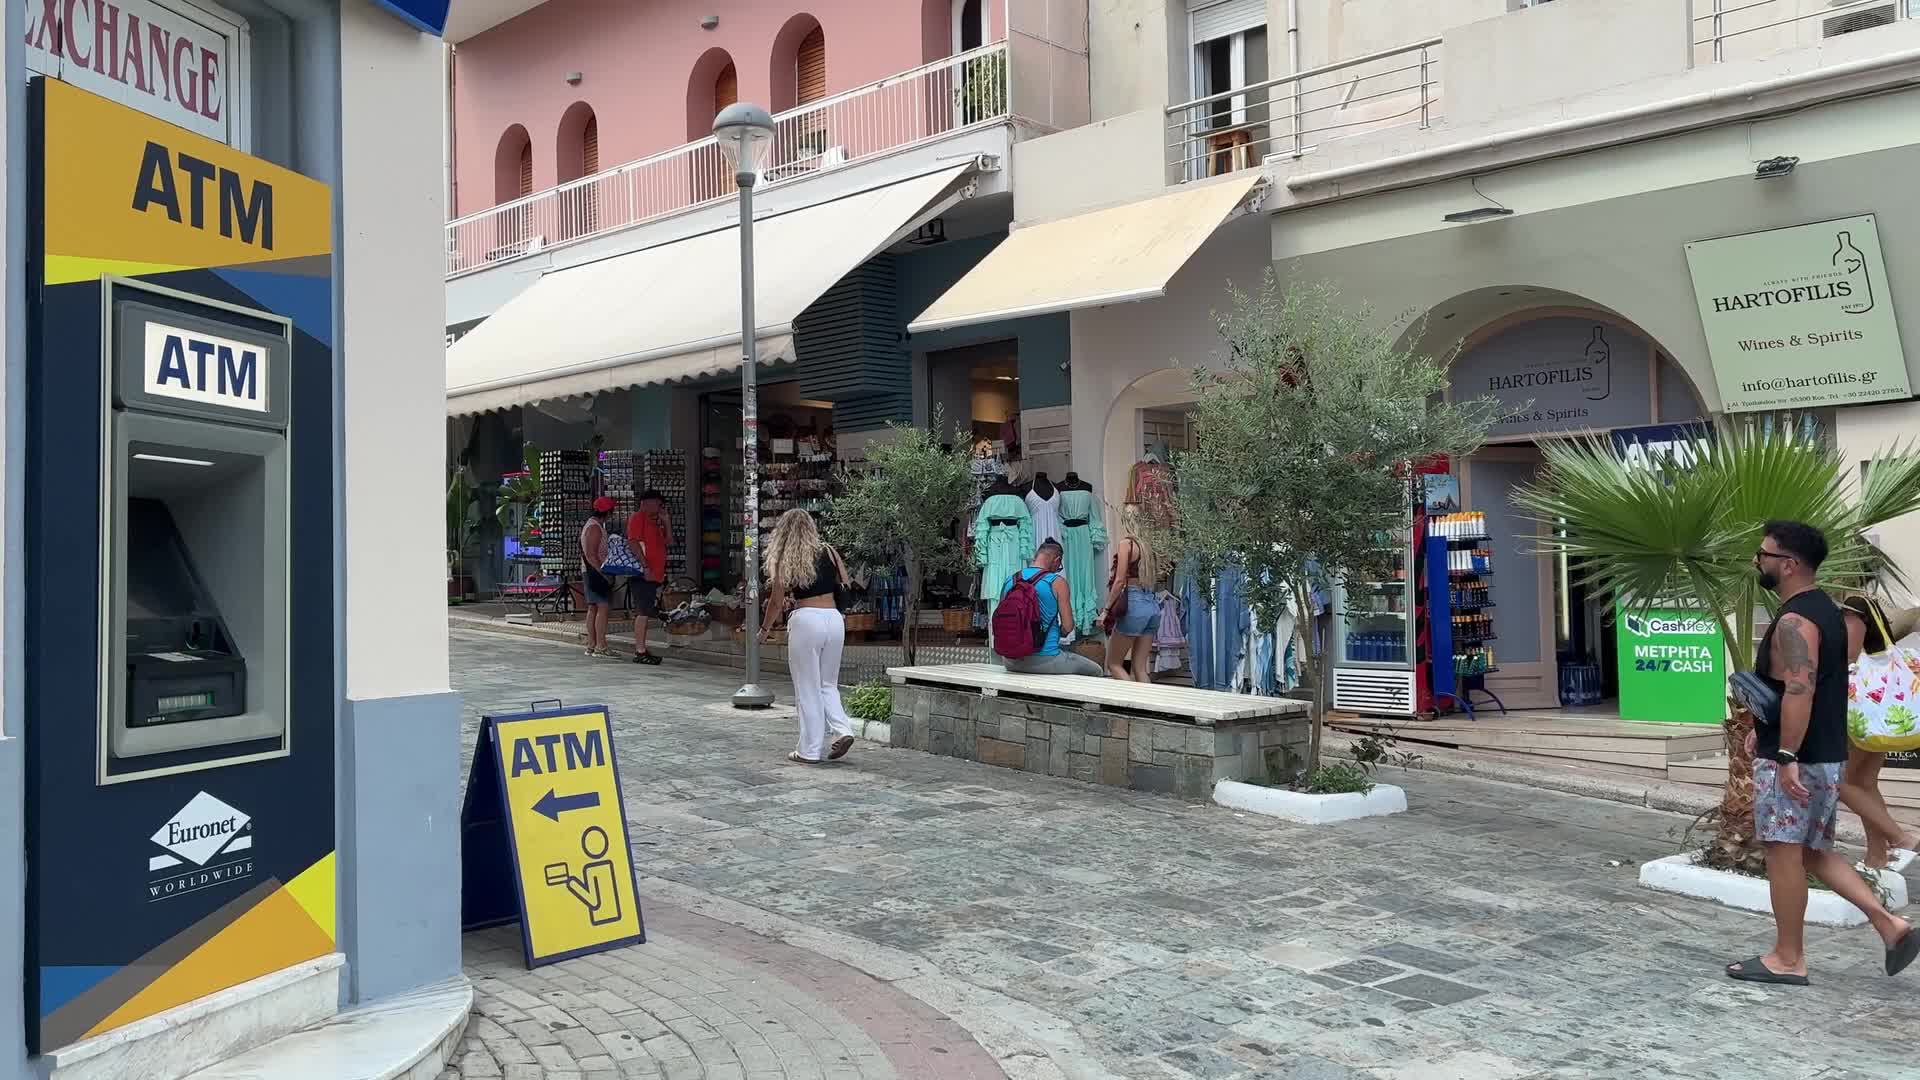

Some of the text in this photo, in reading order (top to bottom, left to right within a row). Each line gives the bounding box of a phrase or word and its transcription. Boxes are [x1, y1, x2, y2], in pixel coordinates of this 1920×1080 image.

[132, 140, 273, 251] ATM
[1712, 281, 1852, 313] HARTOFILIS
[1738, 328, 1864, 352] Wines & Spirits
[156, 334, 257, 400] ATM
[1489, 366, 1593, 391] HARTOFILIS
[1741, 370, 1878, 392] info@hartofilis.gr
[1533, 410, 1543, 421] &
[1546, 408, 1590, 422] Spirits
[1623, 438, 1711, 473] ATM
[1650, 618, 1714, 633] Cashflex
[1635, 646, 1712, 659] ΜΕΤΡΗΤΑ
[511, 729, 605, 777] ATM
[166, 815, 236, 847] Euronet
[149, 862, 253, 897] WORLDWIDE
